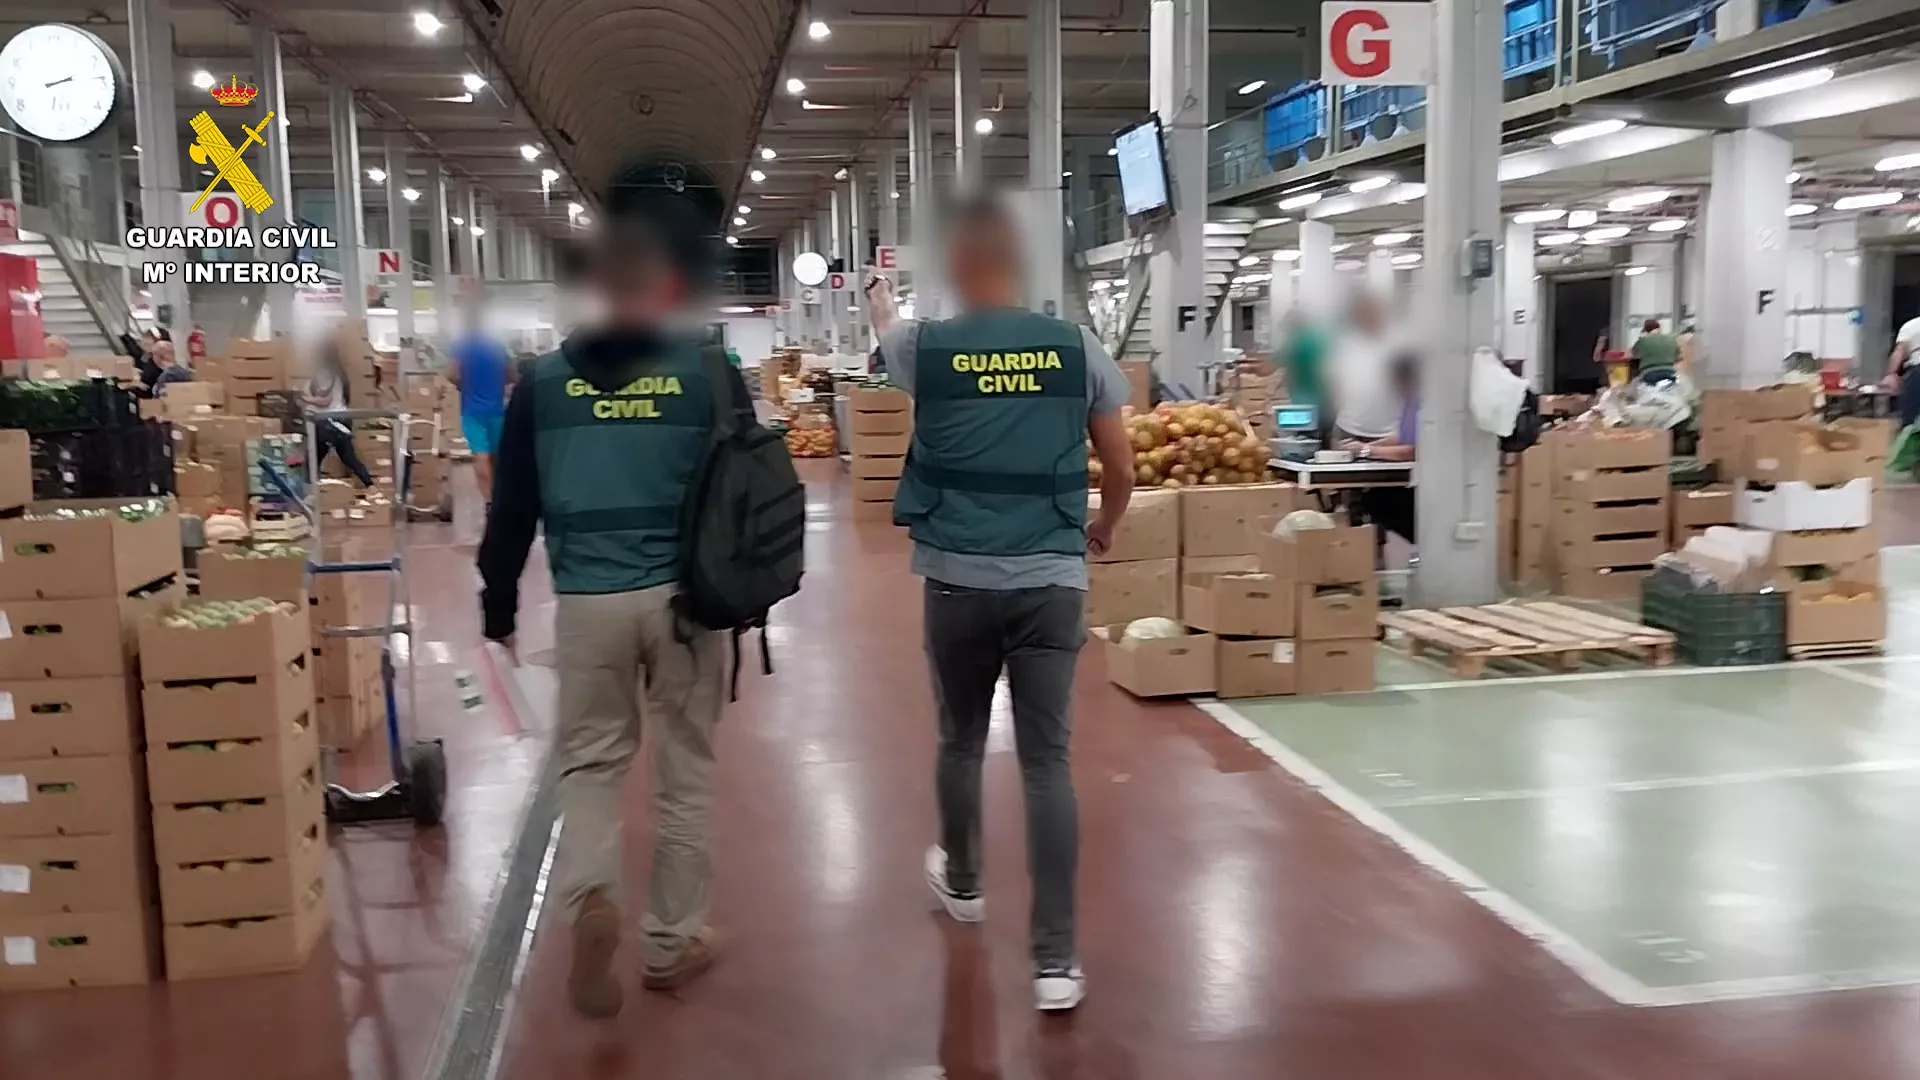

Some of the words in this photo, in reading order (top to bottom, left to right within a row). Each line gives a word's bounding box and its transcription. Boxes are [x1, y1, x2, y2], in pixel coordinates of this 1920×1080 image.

[1330, 9, 1391, 78] G
[205, 197, 238, 229] O
[379, 251, 400, 273] N
[880, 248, 896, 269] E
[831, 274, 845, 290] D
[1757, 290, 1776, 316] F
[1178, 305, 1197, 333] F
[1513, 309, 1526, 325] E
[952, 350, 1063, 373] GUARDIA
[565, 376, 684, 397] GRDIA
[978, 374, 1043, 393] CIVIL
[592, 399, 662, 419] CIVIL
